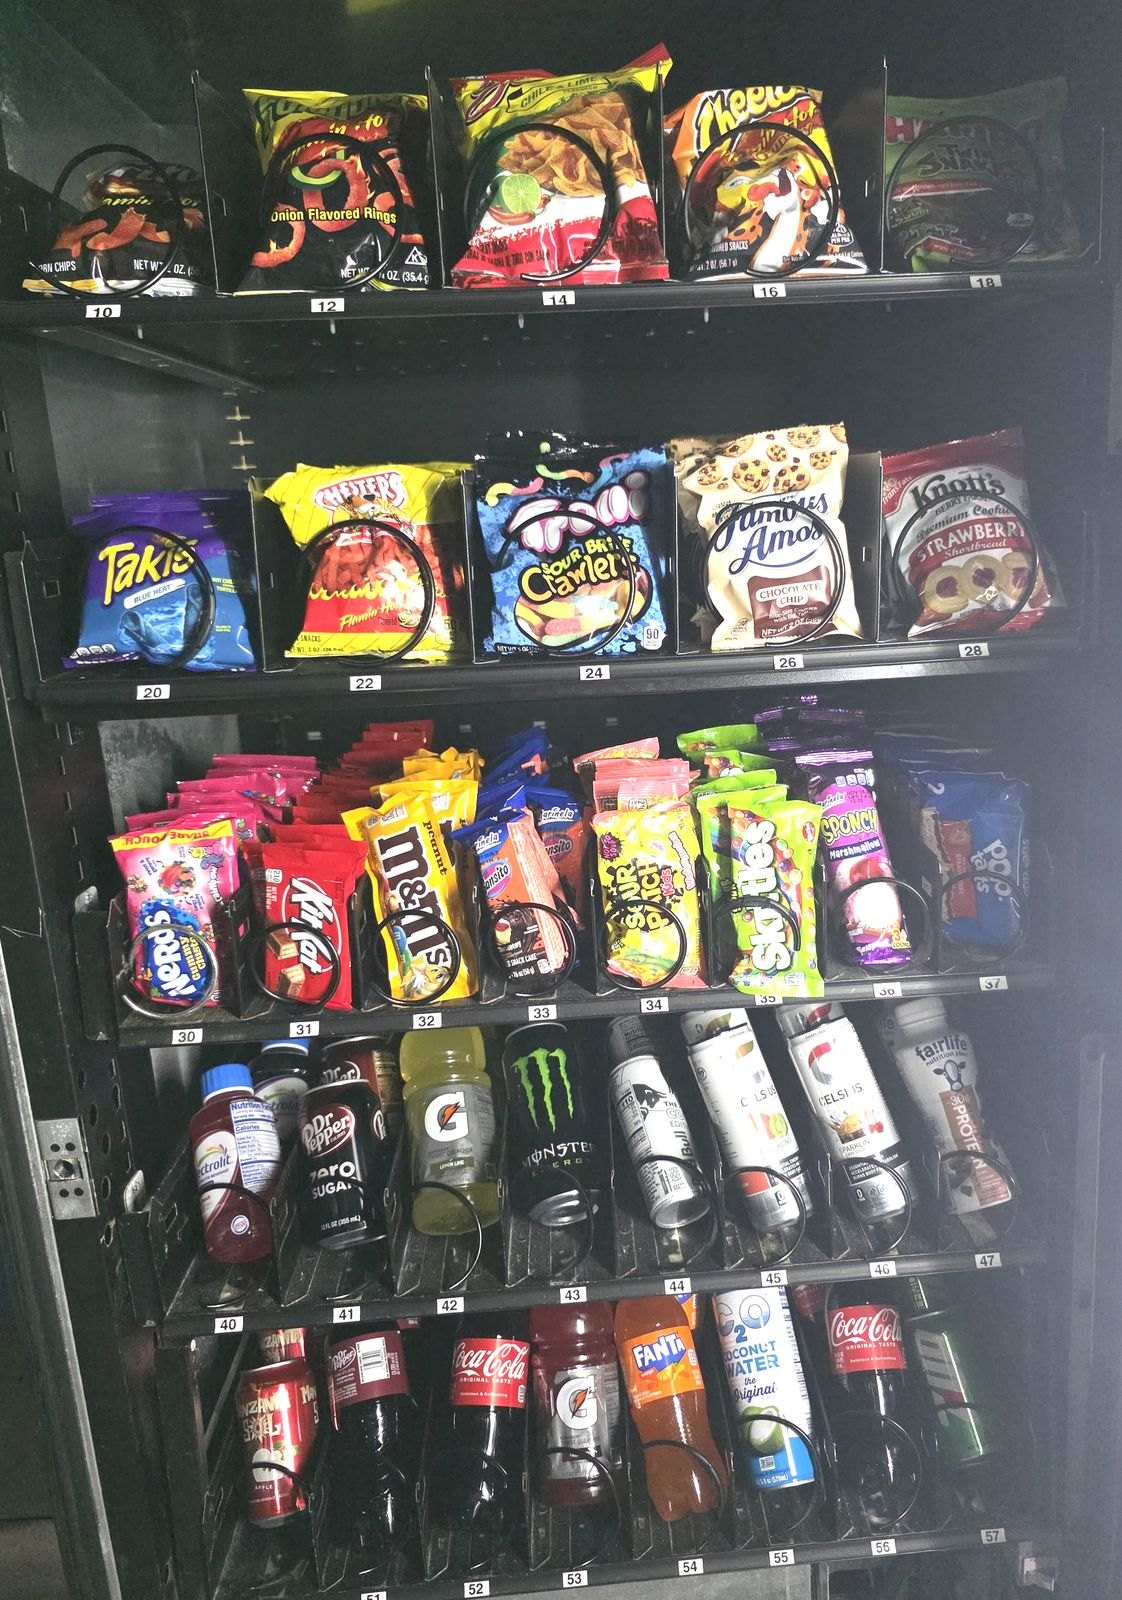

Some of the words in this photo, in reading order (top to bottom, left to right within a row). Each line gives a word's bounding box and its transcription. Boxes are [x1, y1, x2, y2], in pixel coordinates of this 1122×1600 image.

[271, 206, 303, 222] Onion
[309, 208, 359, 221] Flavored
[364, 207, 396, 224] Rings
[54, 260, 76, 272] CHIPS
[134, 259, 148, 270] NET
[341, 268, 355, 278] NET
[976, 277, 995, 288] 18
[760, 287, 778, 297] 16
[550, 294, 568, 305] 14
[93, 306, 112, 317] 10
[317, 301, 336, 312] 12
[911, 474, 1005, 510] Knott's
[935, 496, 961, 516] BERRY
[714, 493, 828, 552] Famous
[917, 520, 1026, 562] STRAWBERRY
[729, 519, 824, 575] Amos
[944, 539, 1006, 561] Shortbread
[542, 549, 581, 575] SOUR
[98, 542, 195, 605] Takis
[134, 590, 151, 603] BLUE
[153, 585, 171, 596] HEAT
[759, 582, 821, 599] CHOCOLATE
[780, 595, 804, 605] CHIP
[646, 628, 659, 640] 90
[964, 645, 982, 656] 28
[779, 657, 797, 668] 26
[585, 668, 603, 679] 24
[356, 678, 374, 689] 22
[143, 687, 162, 698] 20
[542, 806, 575, 820] arinela
[820, 808, 878, 844] SPONCH
[423, 820, 448, 876] peanut
[829, 839, 881, 860] Marshmallow
[485, 863, 510, 893] ansito
[984, 978, 1001, 989] 37
[760, 995, 776, 1004] 35
[645, 1000, 662, 1011] 34
[533, 1007, 550, 1018] 33
[418, 1016, 435, 1027] 32
[296, 1024, 312, 1035] 31
[178, 1031, 195, 1042] 30
[915, 1033, 968, 1062] fairlife
[926, 1051, 954, 1068] nutrition
[740, 1084, 778, 1108] CLSUS
[424, 1091, 469, 1142] G
[236, 1124, 260, 1132] Calories
[312, 1112, 333, 1136] Dr
[302, 1115, 351, 1156] Pepper
[953, 1103, 987, 1169] PROTEN
[198, 1152, 232, 1177] ctrolit
[979, 1255, 994, 1266] 47
[874, 1264, 890, 1275] 46
[766, 1273, 781, 1284] 45
[669, 1281, 685, 1292] 44
[564, 1290, 580, 1301] 43
[441, 1300, 458, 1311] 42
[339, 1309, 354, 1320] 41
[220, 1320, 236, 1331] 40
[832, 1309, 902, 1343] Coca-Cola
[633, 1333, 686, 1368] FANTA
[723, 1340, 777, 1362] COCONUT
[846, 1342, 876, 1350] ORIGINAL
[455, 1342, 529, 1380] Coca-Cola
[725, 1354, 781, 1379] WATER
[744, 1377, 757, 1386] the
[556, 1375, 598, 1430] G
[985, 1531, 999, 1542] 57
[876, 1542, 890, 1553] 56
[774, 1552, 788, 1563] 55
[683, 1561, 697, 1572] 54
[567, 1573, 582, 1584] 53
[468, 1584, 483, 1595] 52
